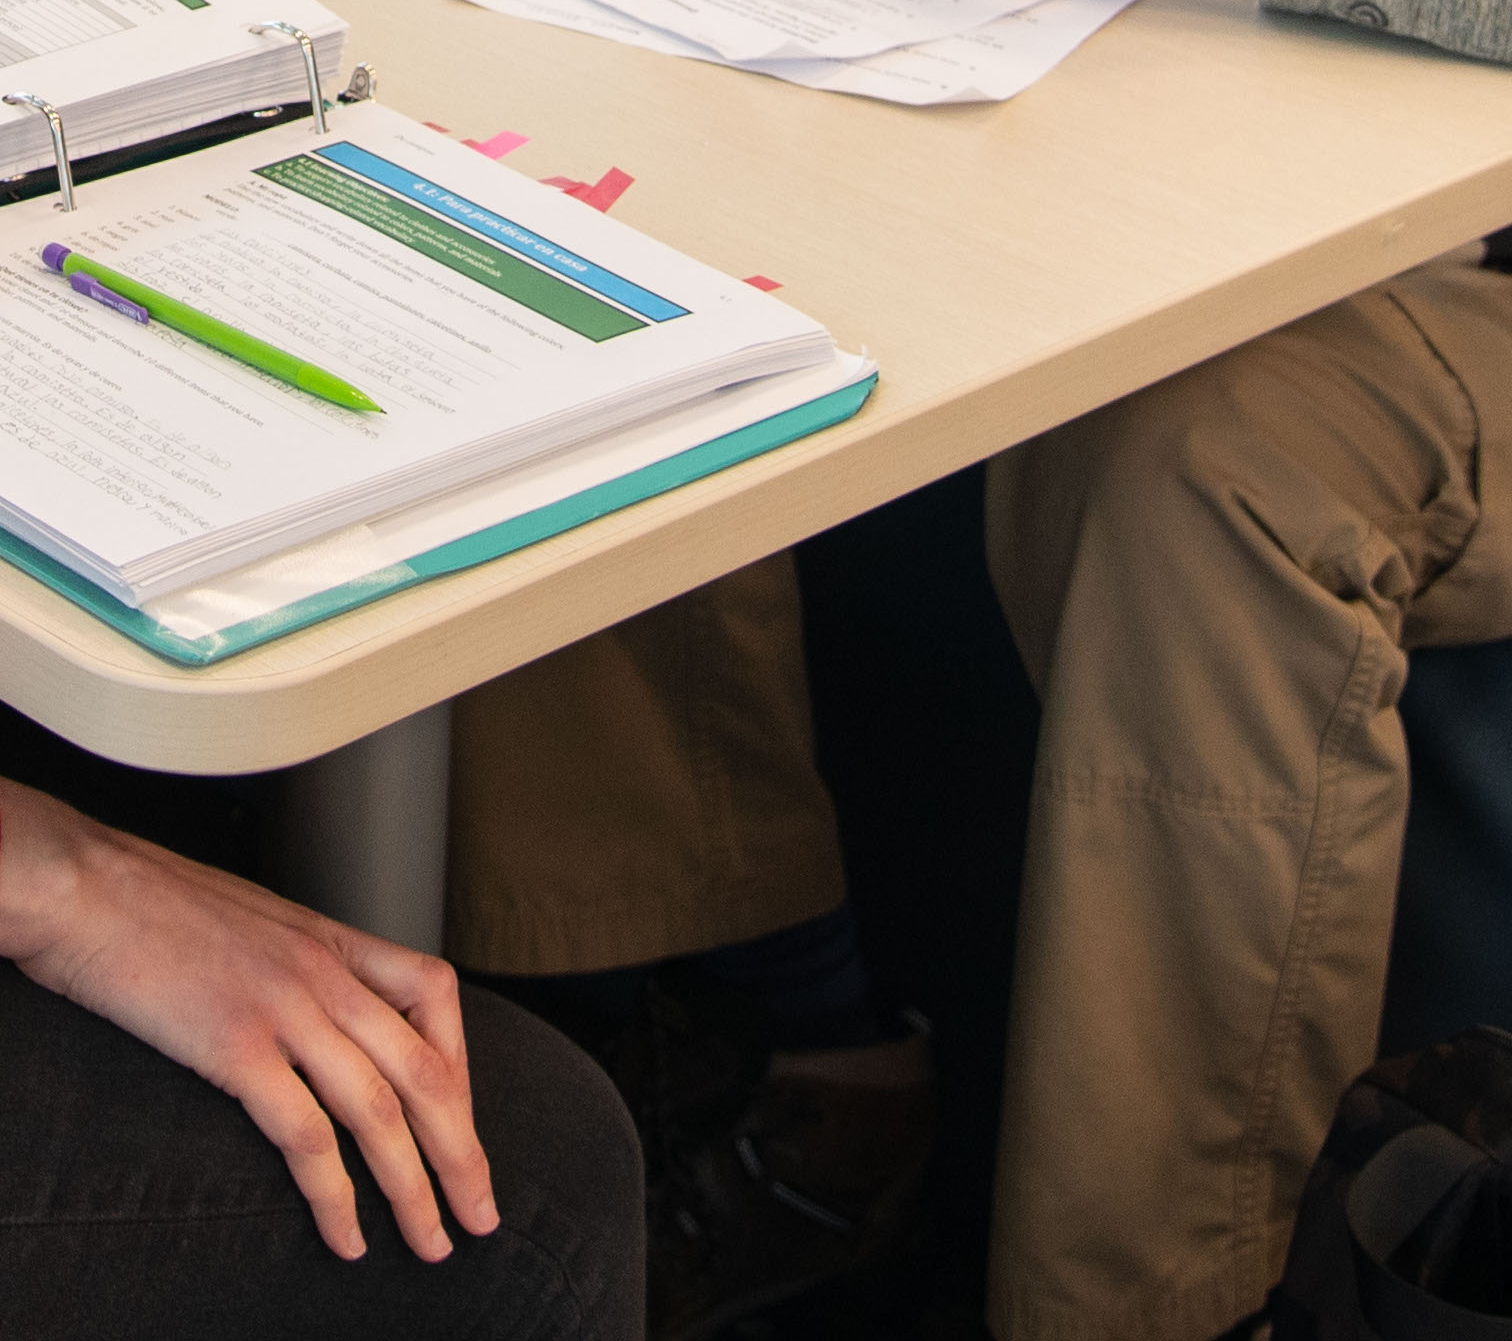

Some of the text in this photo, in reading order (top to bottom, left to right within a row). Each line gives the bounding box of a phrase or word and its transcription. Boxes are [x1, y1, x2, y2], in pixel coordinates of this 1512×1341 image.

[413, 183, 439, 197] 4.1:
[438, 195, 472, 214] Para
[467, 212, 537, 244] practicar
[554, 254, 587, 272] casa
